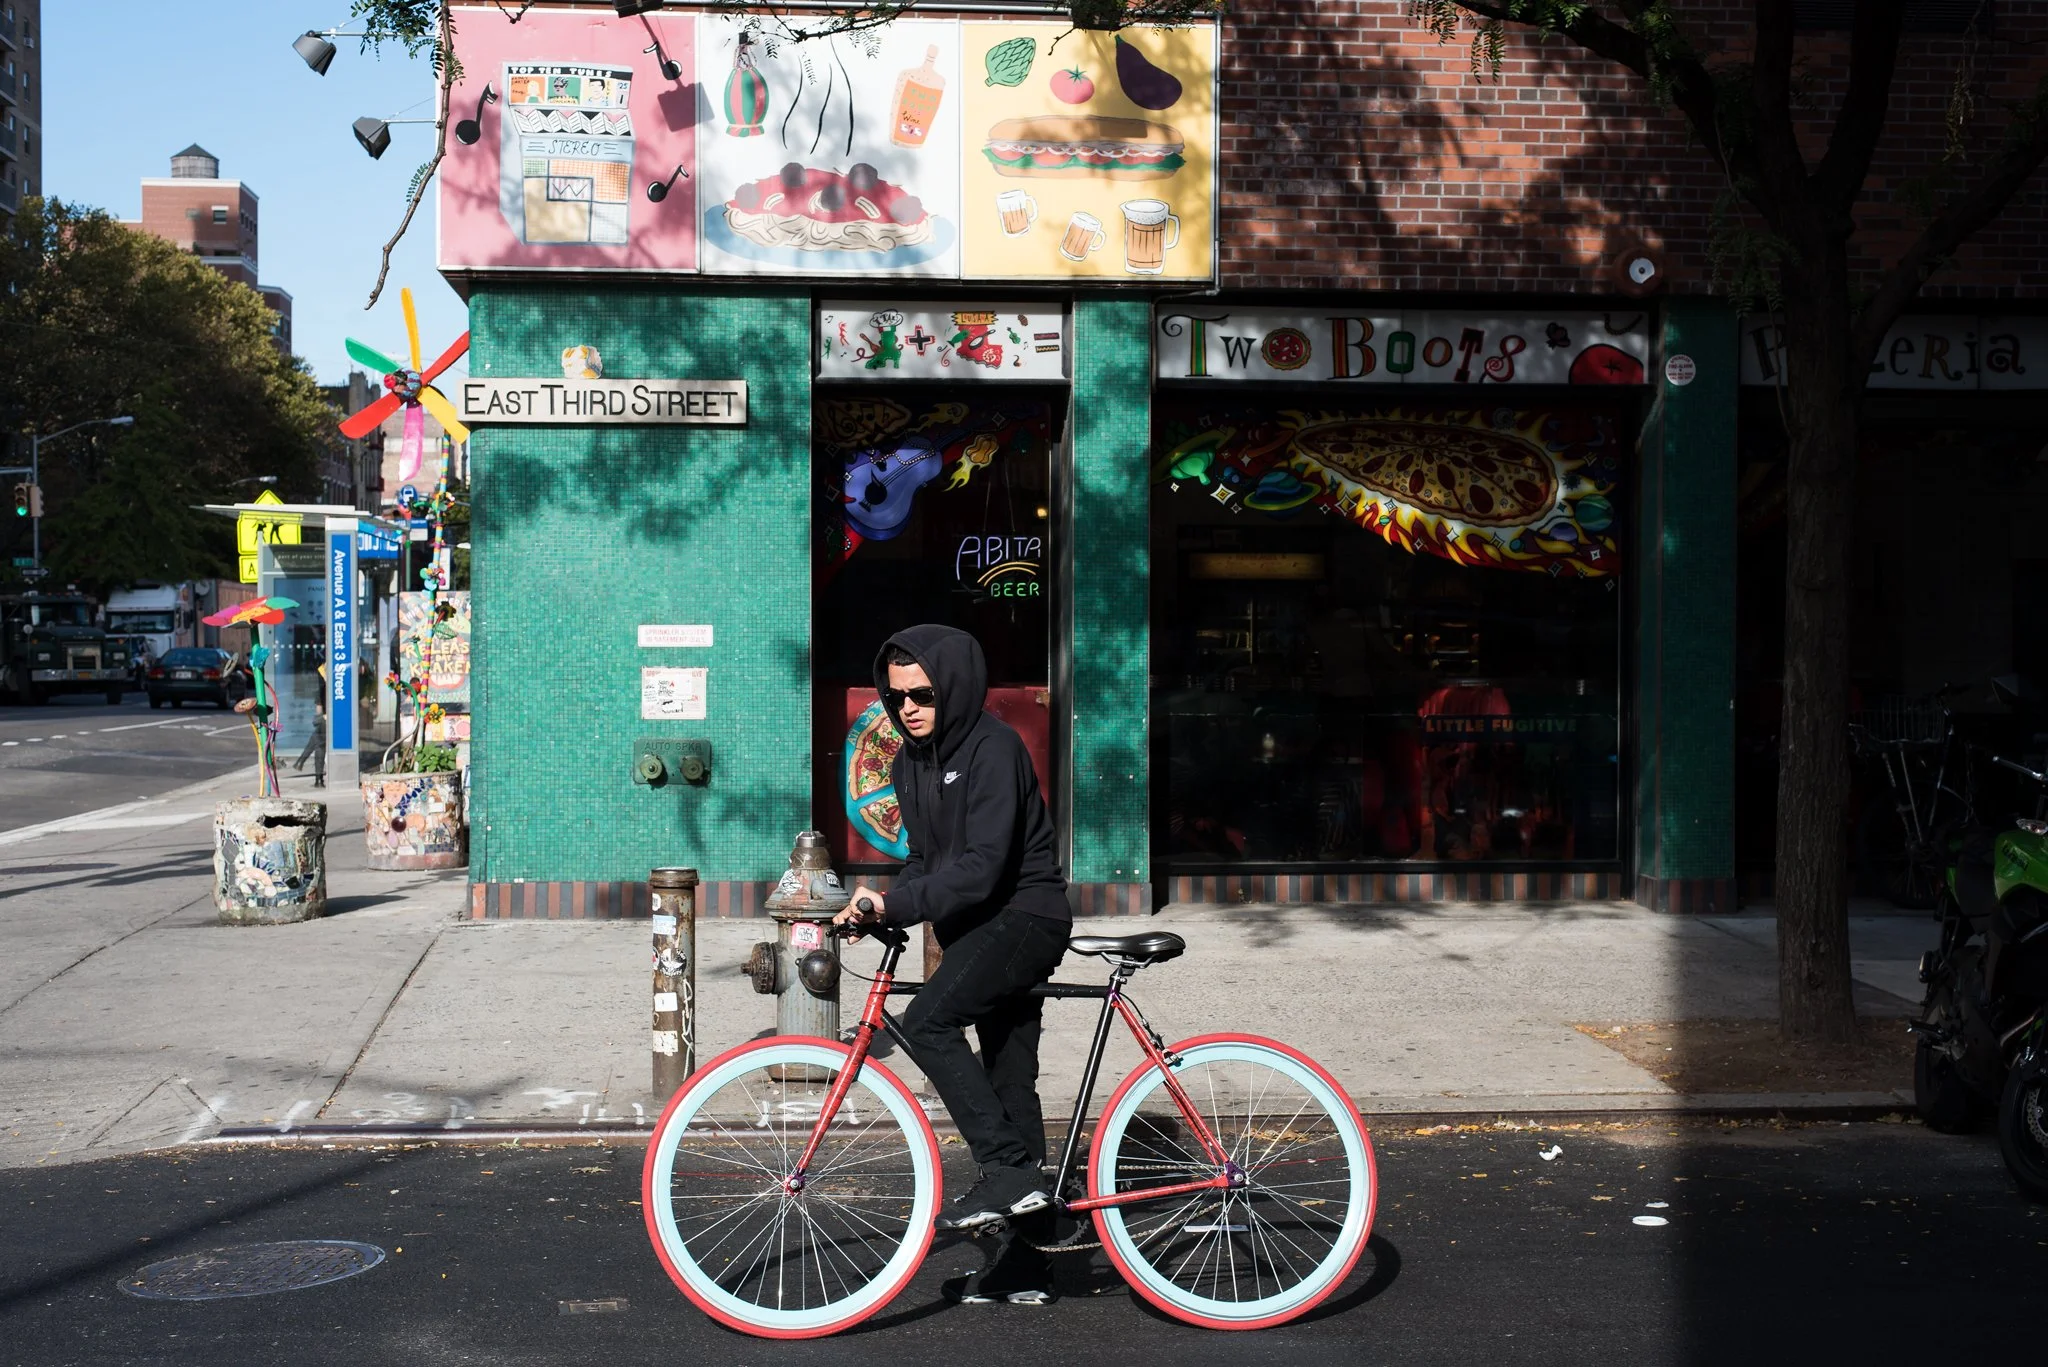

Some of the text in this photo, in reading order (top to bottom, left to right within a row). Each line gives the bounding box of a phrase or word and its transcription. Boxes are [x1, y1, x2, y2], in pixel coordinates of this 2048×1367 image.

[570, 68, 613, 78] TUNES
[548, 139, 602, 156] STEREO
[464, 384, 739, 417] EAST THIRD STREET
[956, 535, 1042, 580] ABITA
[991, 582, 1040, 597] BEER
[334, 549, 346, 701] Avenue A & East 3 Street
[1426, 719, 1578, 733] LITTLE FUGITIVE
[644, 741, 671, 751] AUTO
